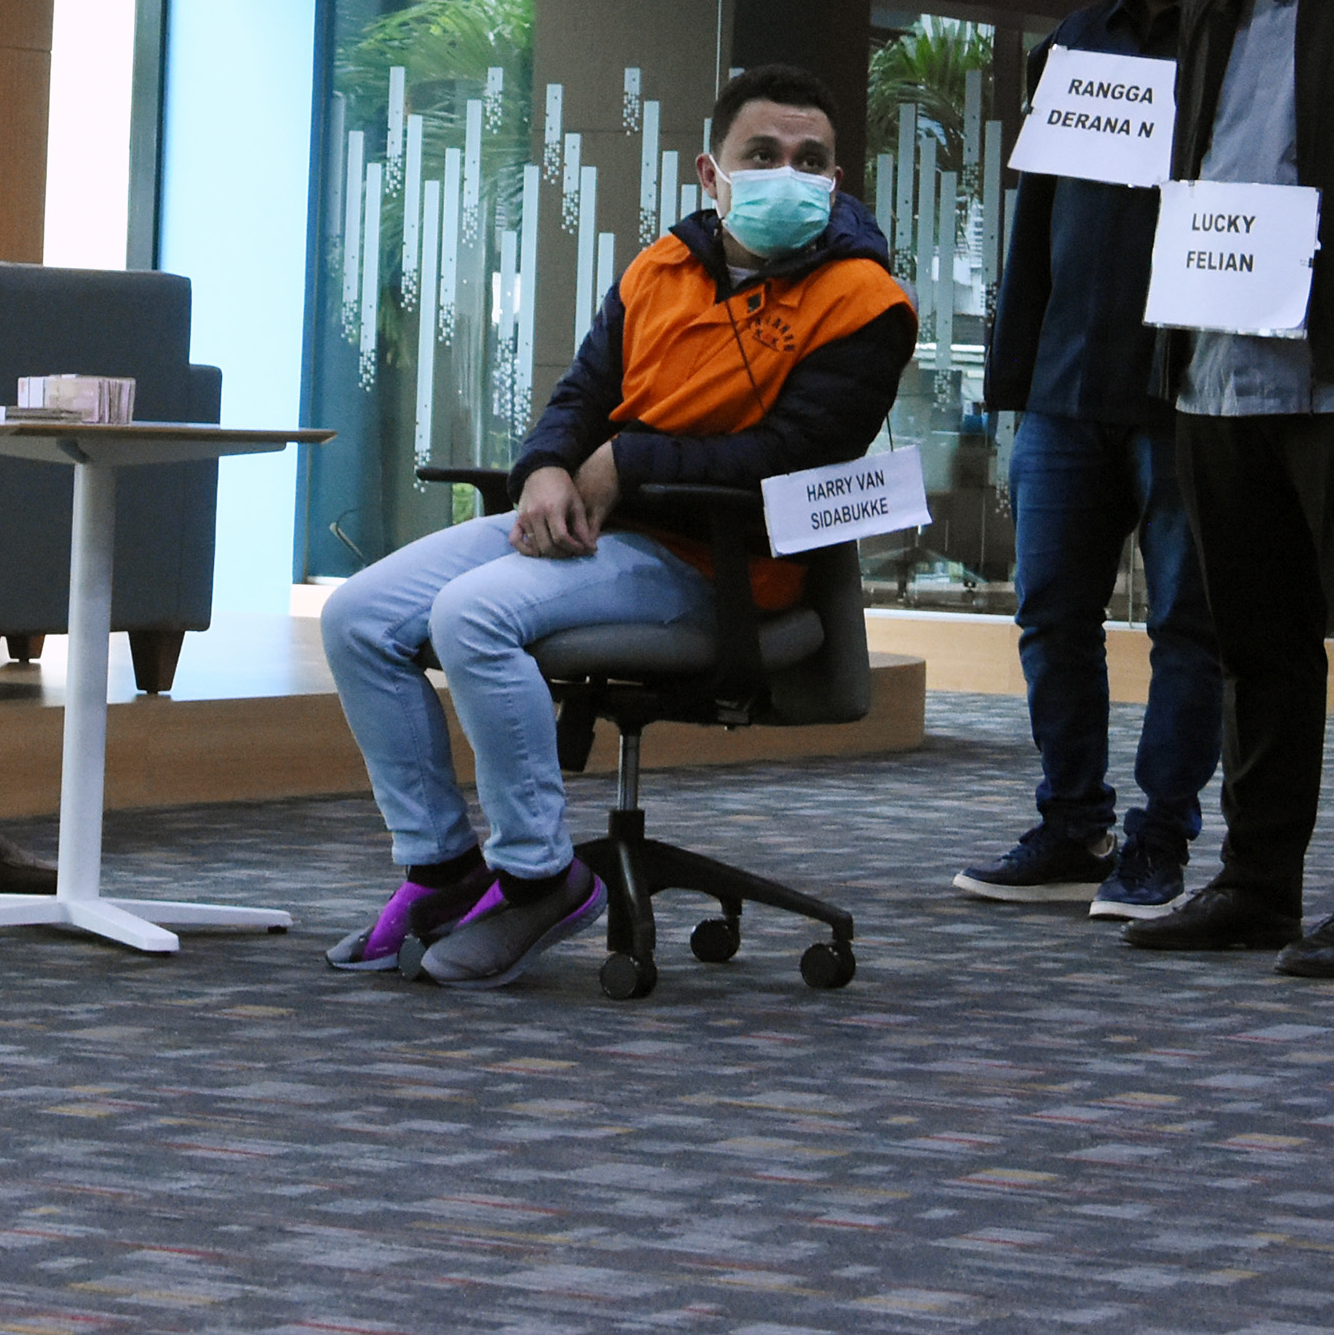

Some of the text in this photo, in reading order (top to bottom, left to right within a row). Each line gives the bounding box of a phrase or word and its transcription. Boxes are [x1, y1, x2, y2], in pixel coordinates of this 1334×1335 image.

[1067, 78, 1153, 105] RANGGA
[1047, 109, 1155, 139] DERANA N
[1191, 212, 1256, 234] LUCKY
[1186, 250, 1254, 273] FELIAN
[806, 470, 885, 502] HARRY VAN
[811, 497, 889, 530] SIDABUKKE
